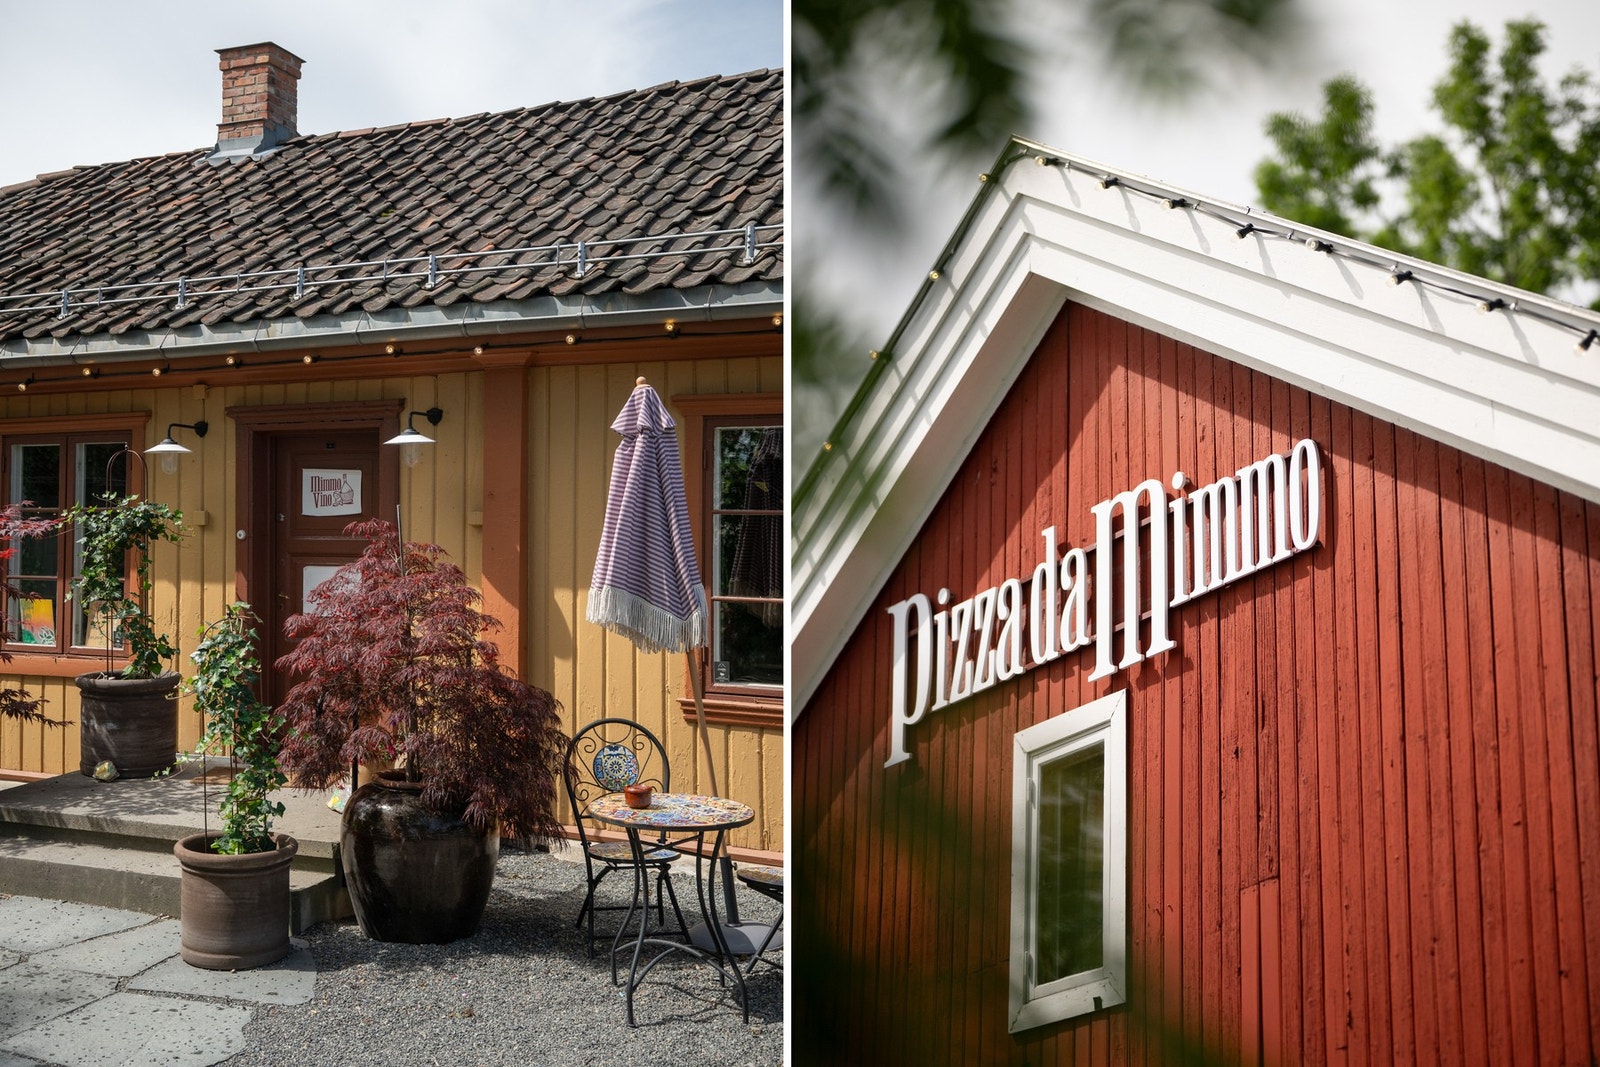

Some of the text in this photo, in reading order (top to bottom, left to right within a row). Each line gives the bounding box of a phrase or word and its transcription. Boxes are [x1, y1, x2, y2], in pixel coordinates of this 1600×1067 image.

[310, 475, 342, 492] Mimmo
[313, 492, 333, 509] Vino
[1030, 526, 1091, 664] da
